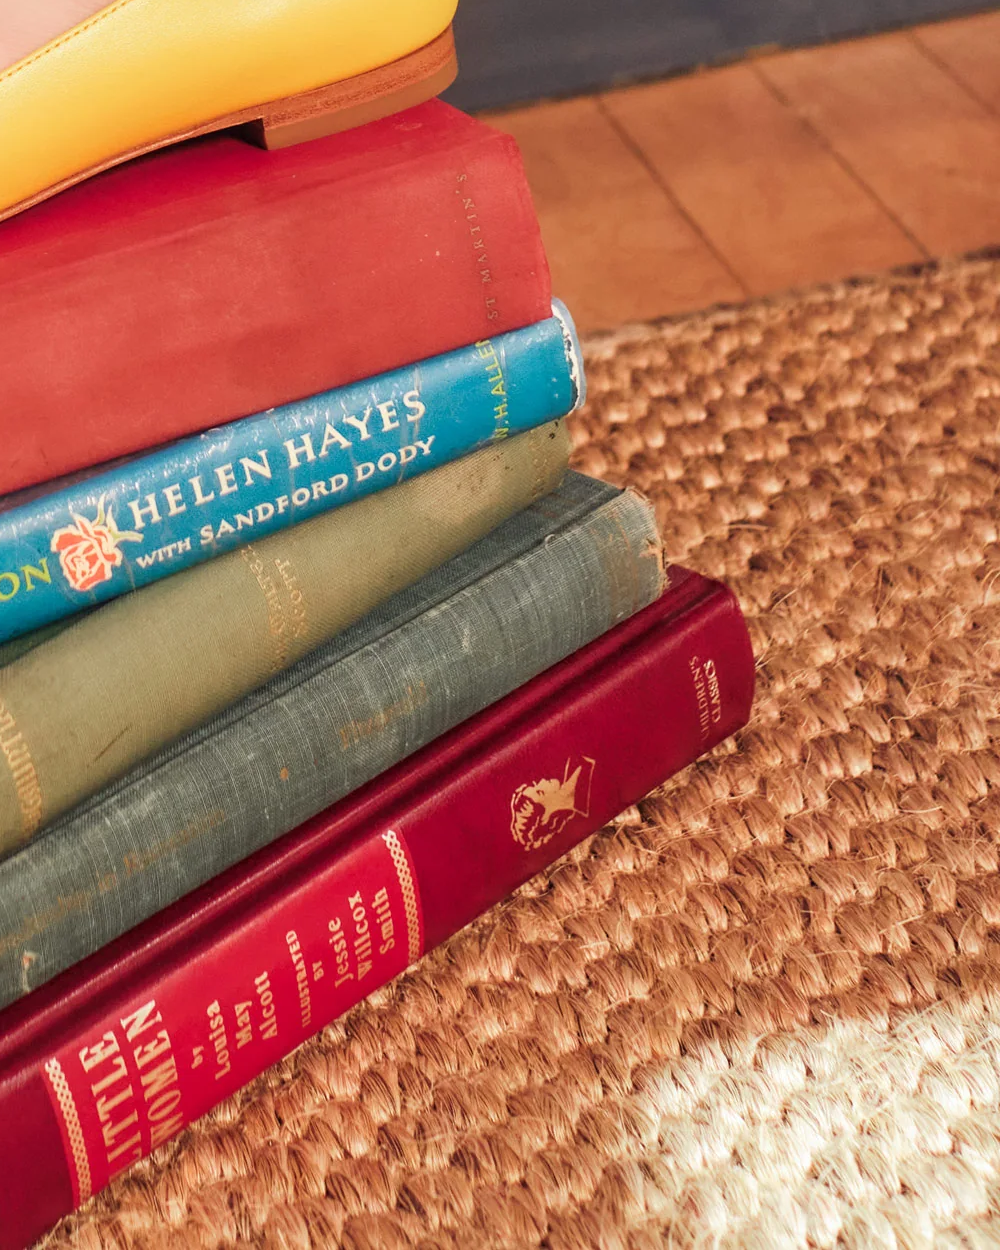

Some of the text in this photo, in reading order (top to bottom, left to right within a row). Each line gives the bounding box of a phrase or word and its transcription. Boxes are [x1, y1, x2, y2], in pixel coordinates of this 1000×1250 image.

[127, 389, 427, 531] HELEN HAYES
[135, 435, 437, 569] WITH SANDFORD DODY
[702, 659, 722, 724] CLASSICS
[327, 916, 354, 990] Jessie
[348, 890, 373, 982] Willcox
[371, 886, 395, 955] Smith
[254, 970, 278, 1041] Alcott
[285, 929, 312, 1029] ILLUSTRATED
[311, 960, 325, 982] BY
[206, 999, 231, 1081] Louisa
[234, 1000, 253, 1050] May
[120, 999, 184, 1150] WOMEN
